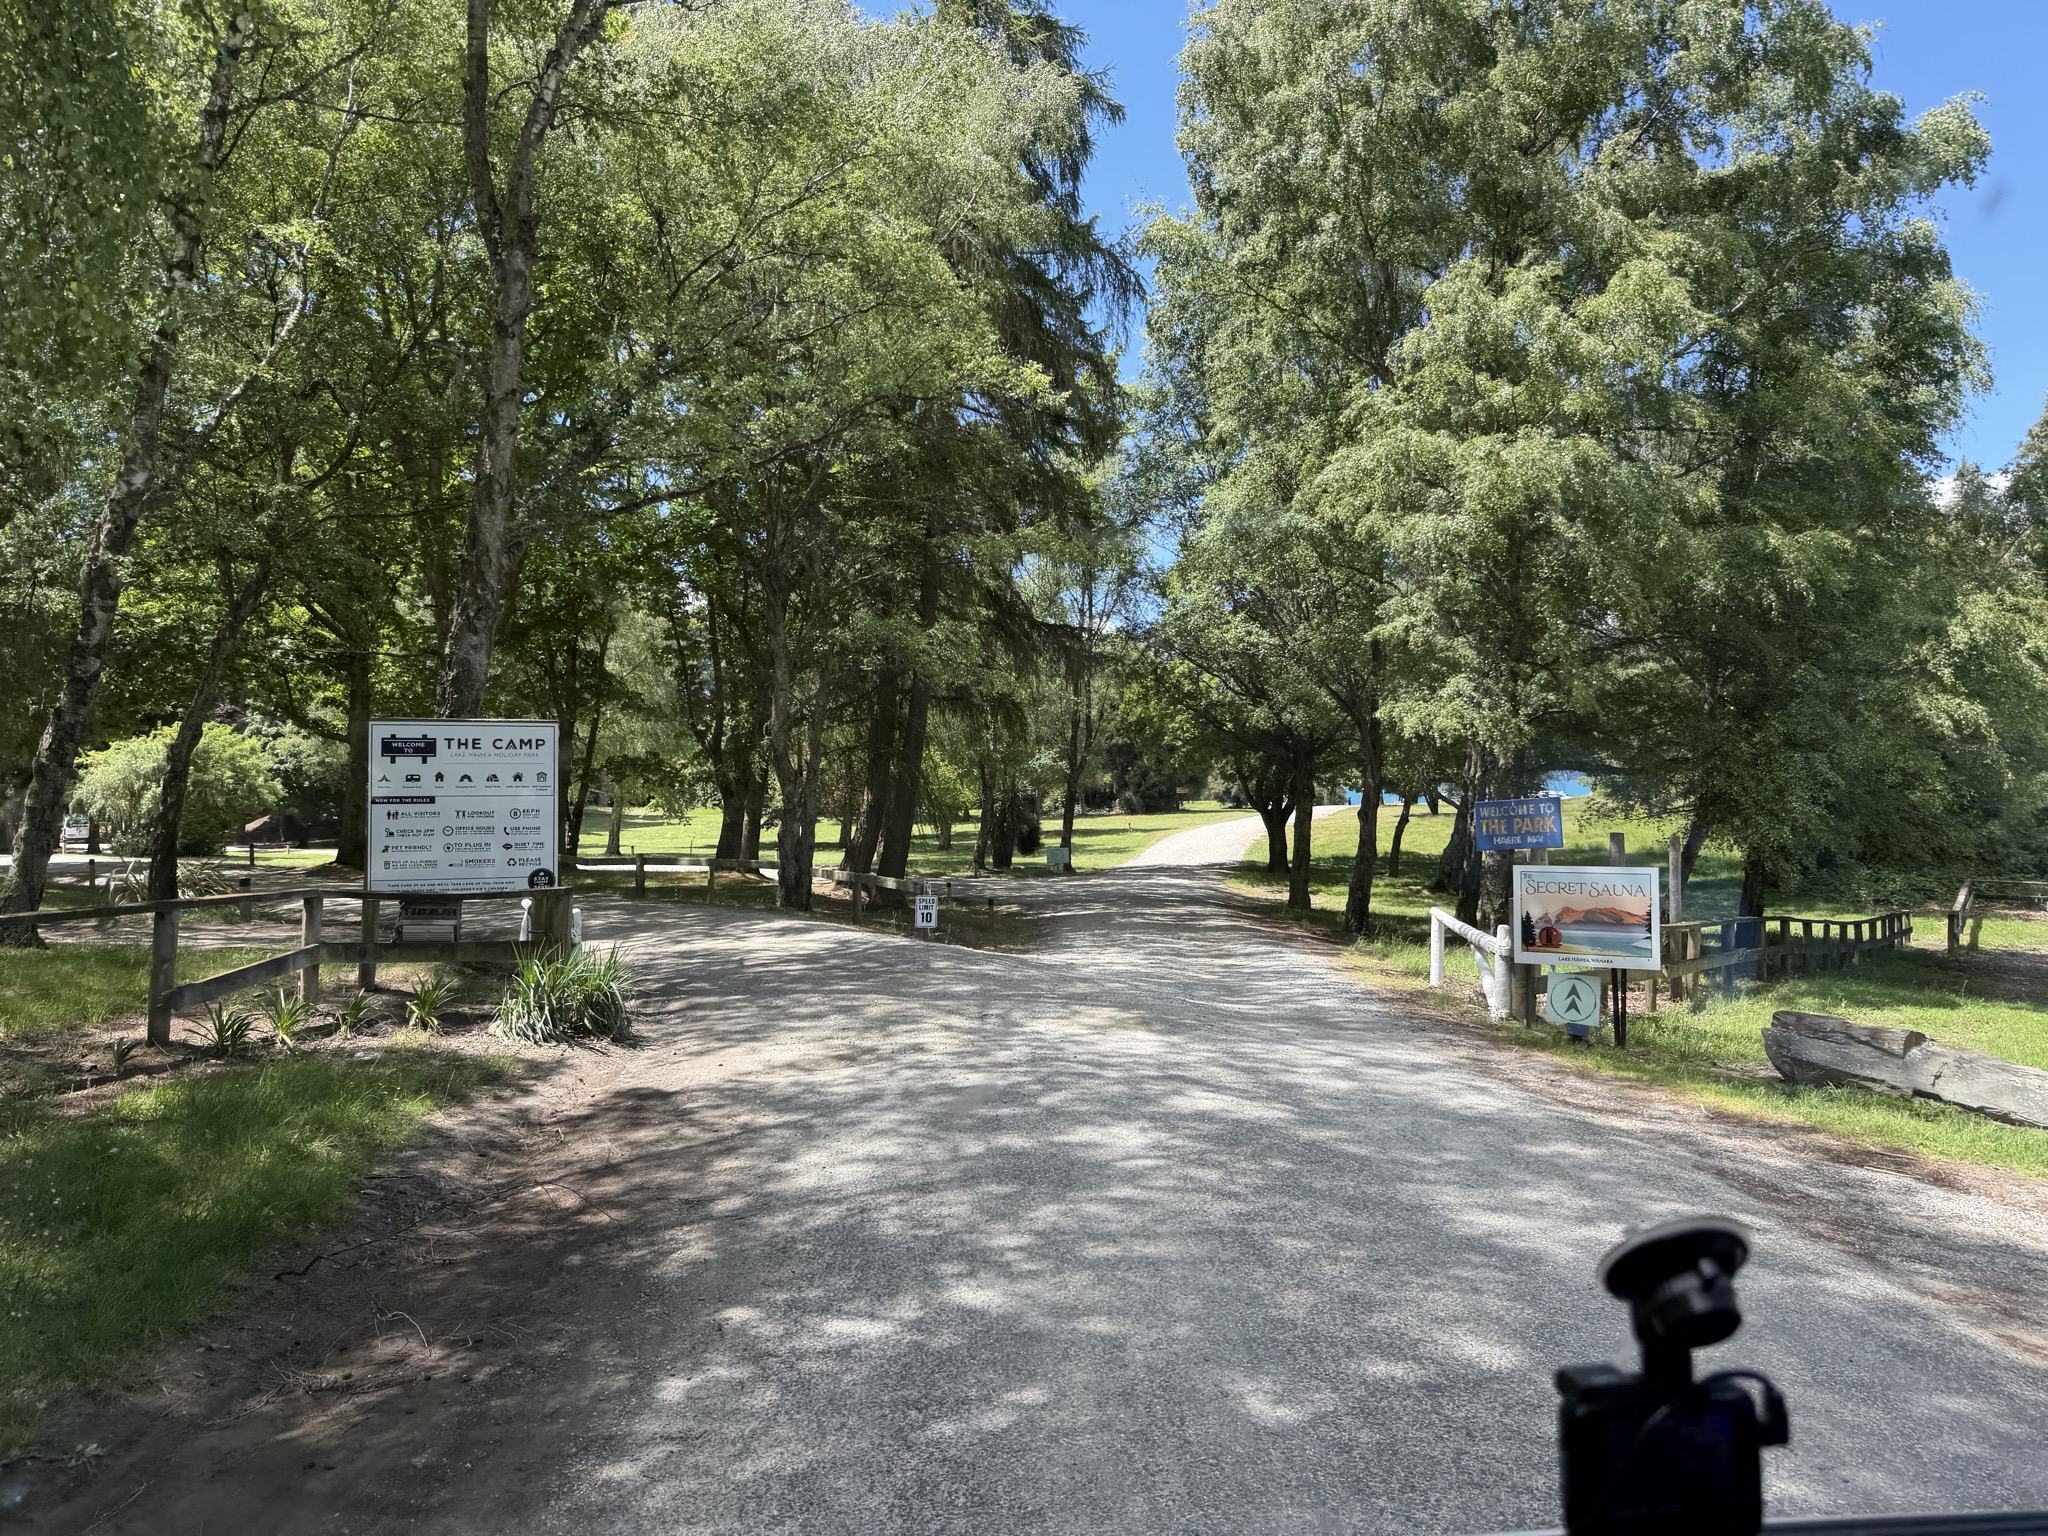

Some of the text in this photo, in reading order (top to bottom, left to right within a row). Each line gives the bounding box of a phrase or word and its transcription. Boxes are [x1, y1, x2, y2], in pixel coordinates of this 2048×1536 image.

[443, 737, 546, 750] THE CAMP
[1480, 802, 1555, 818] WELCOME TO
[1480, 816, 1558, 836] THE PARK
[1494, 835, 1544, 844] HAERE MAI
[1525, 880, 1646, 898] SECRET SAUNA
[921, 912, 932, 923] 10
